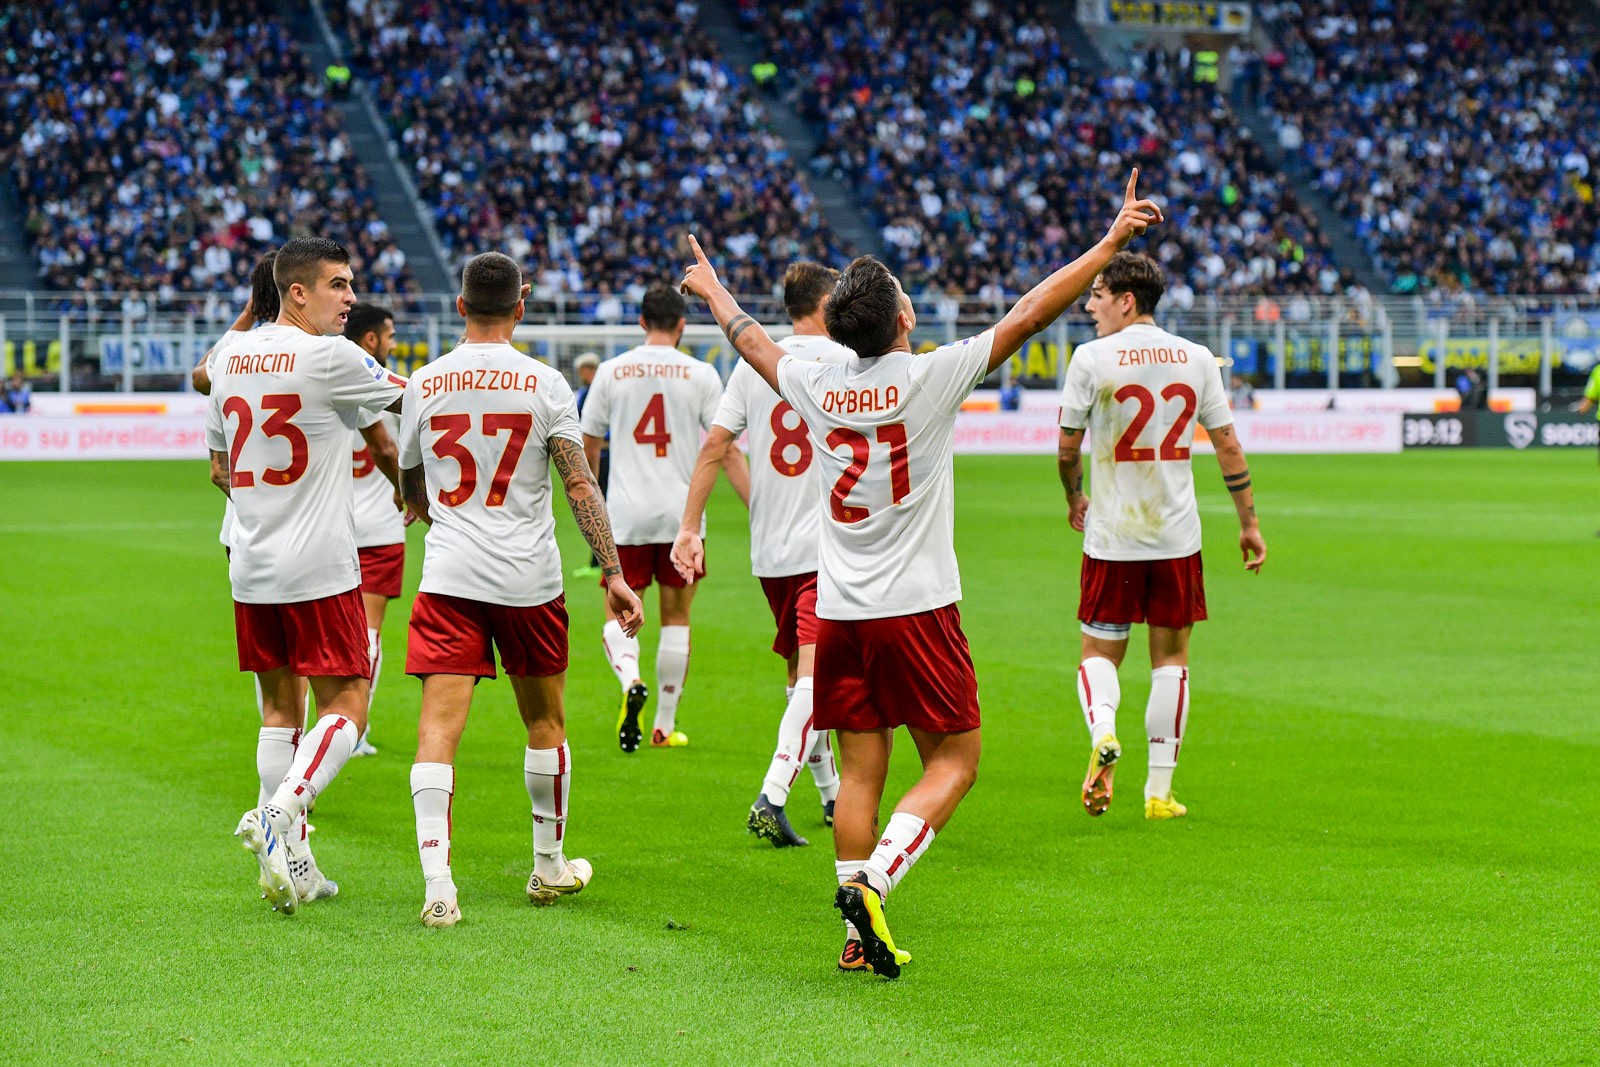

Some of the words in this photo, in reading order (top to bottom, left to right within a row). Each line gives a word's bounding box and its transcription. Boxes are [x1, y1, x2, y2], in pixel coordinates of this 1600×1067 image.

[226, 352, 296, 376] MANCINI
[613, 363, 691, 381] CRISTANTE
[1117, 347, 1188, 367] ZANIOLO
[422, 369, 537, 400] SPINAZZOLA
[822, 385, 899, 414] DYBALA
[78, 423, 208, 452] pirellicar
[222, 393, 309, 488] 23
[632, 393, 672, 458] 4
[769, 400, 814, 478] 8
[1113, 382, 1198, 463] 22
[430, 412, 534, 508] 37
[825, 421, 912, 524] 21
